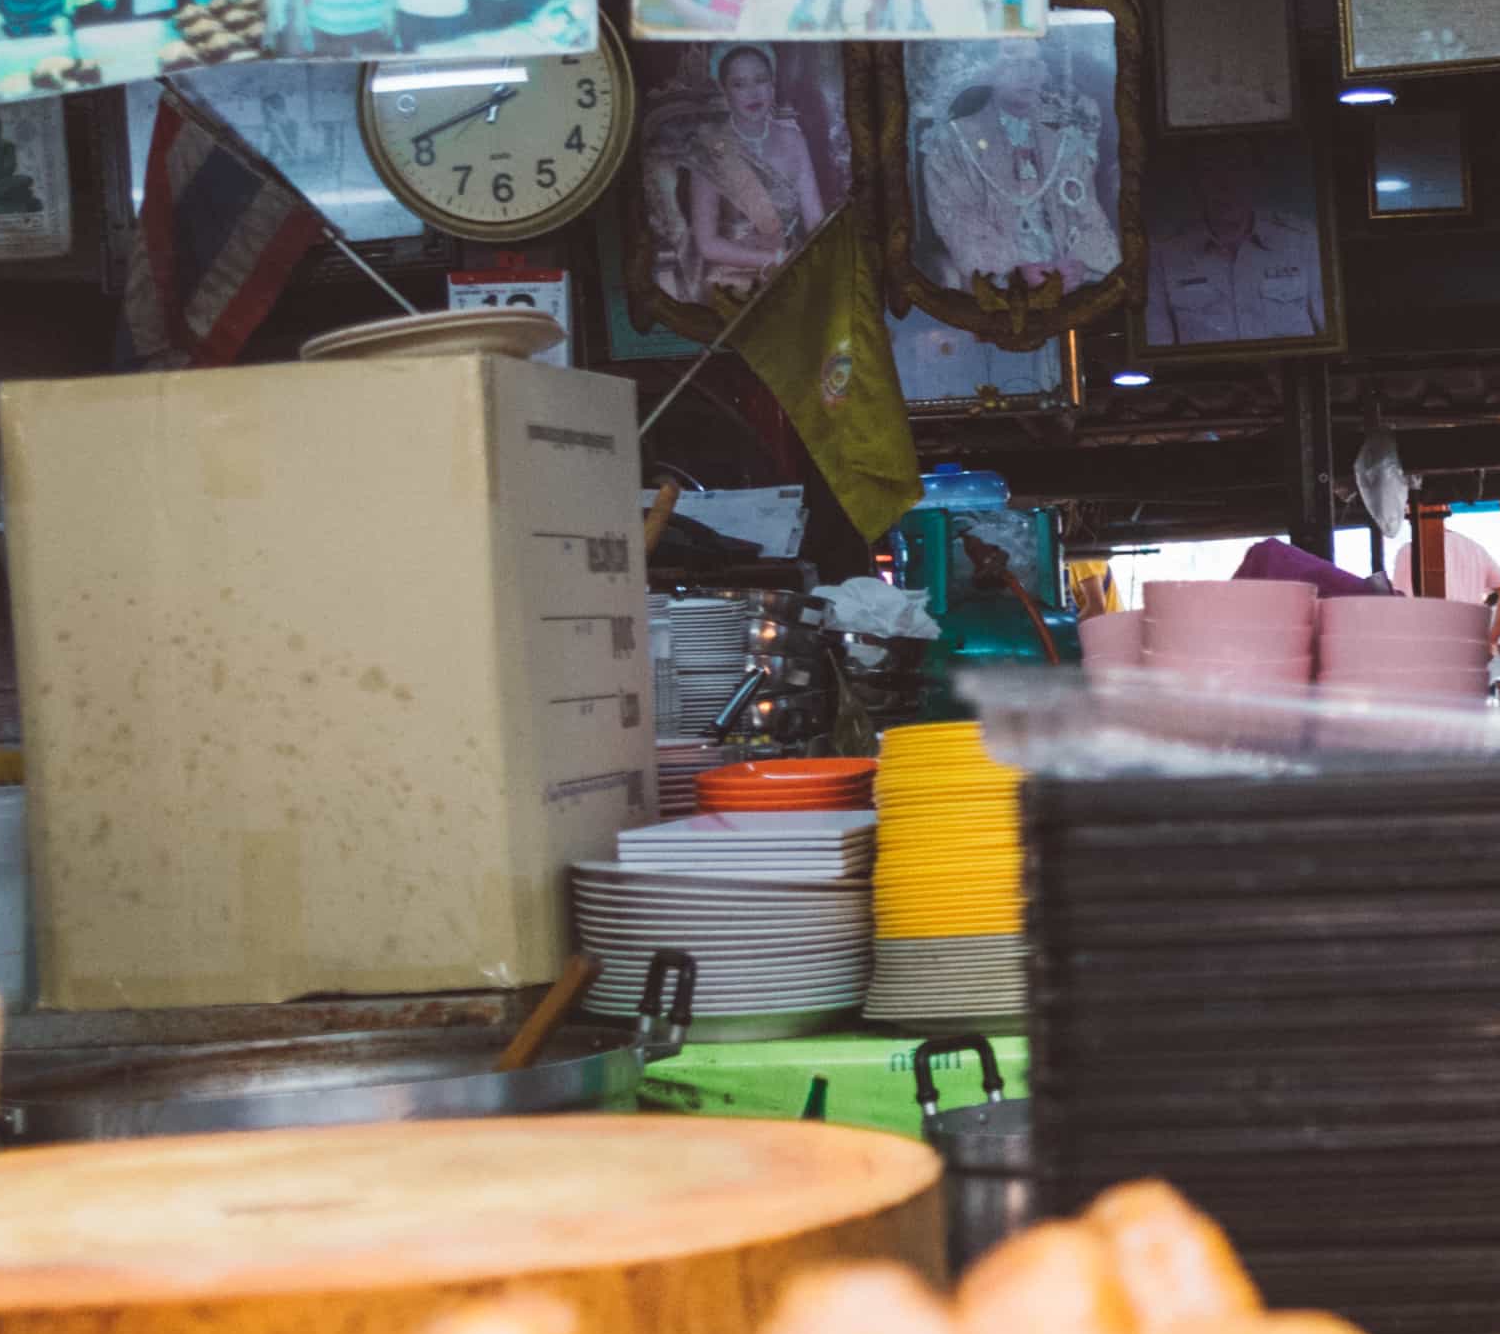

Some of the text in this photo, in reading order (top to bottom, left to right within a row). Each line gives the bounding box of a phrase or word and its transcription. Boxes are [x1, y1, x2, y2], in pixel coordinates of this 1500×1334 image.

[576, 77, 597, 109] 3
[414, 136, 436, 166] 8
[564, 124, 586, 153] 4
[452, 164, 473, 195] 7
[491, 172, 515, 202] 6
[536, 158, 557, 188] 5
